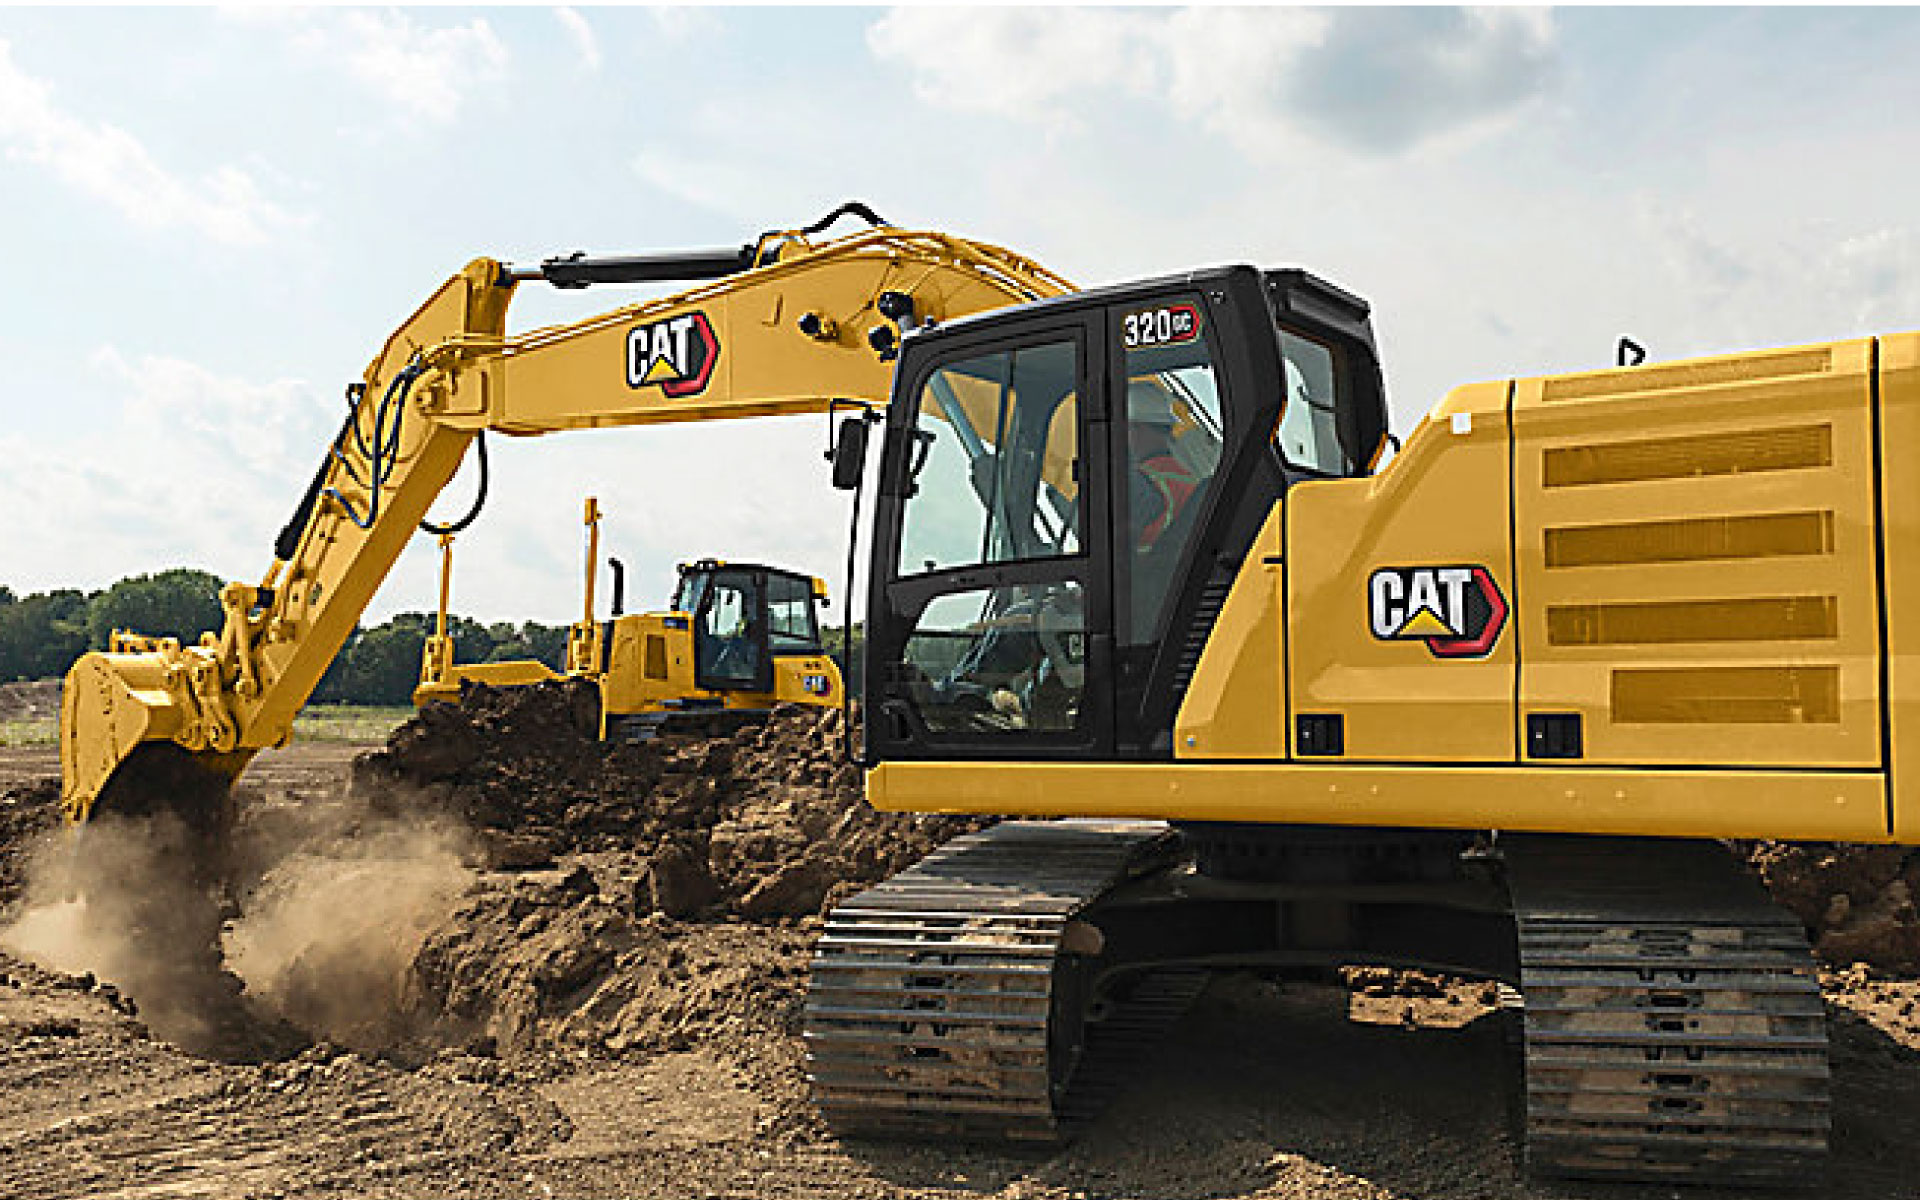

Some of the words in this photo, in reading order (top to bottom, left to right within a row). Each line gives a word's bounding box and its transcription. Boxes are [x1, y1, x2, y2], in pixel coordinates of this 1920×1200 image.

[628, 315, 694, 385] CAT
[1125, 309, 1170, 345] 320
[1372, 569, 1471, 638] CAT
